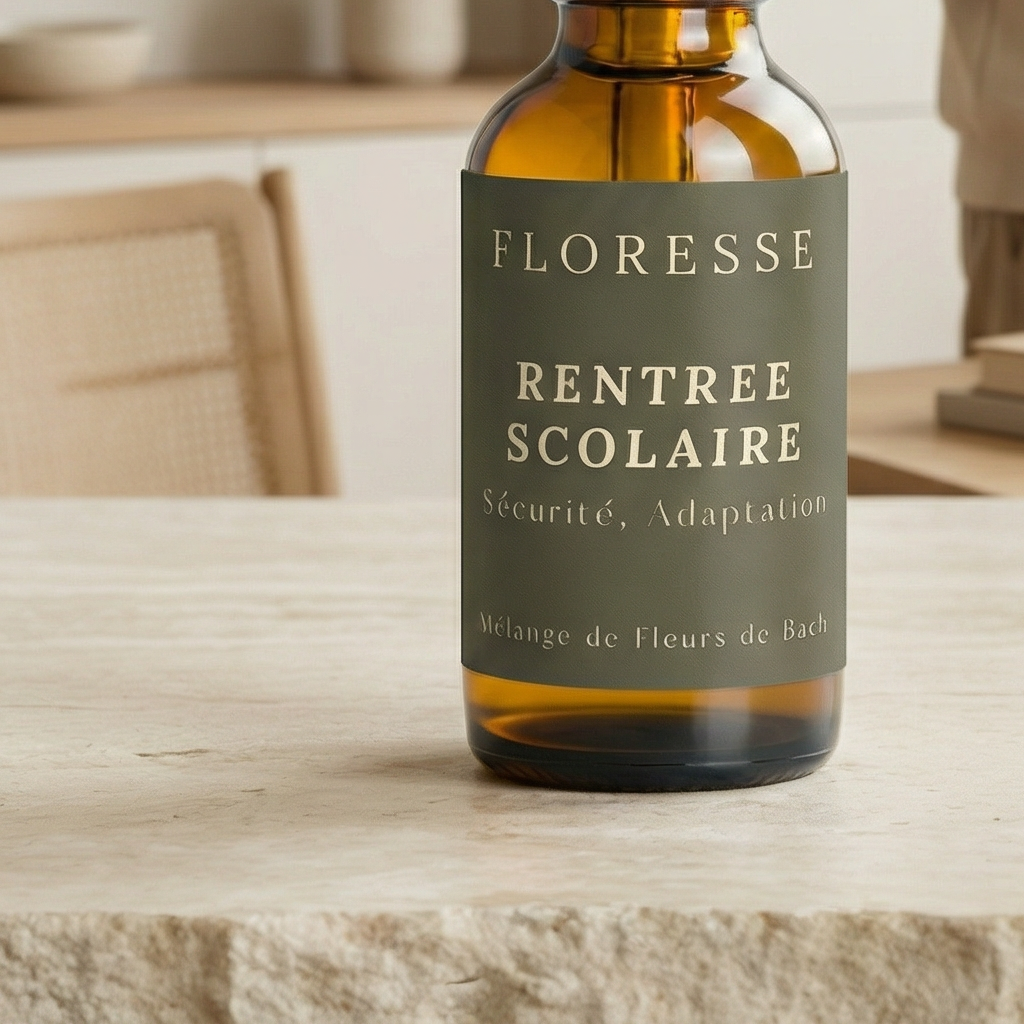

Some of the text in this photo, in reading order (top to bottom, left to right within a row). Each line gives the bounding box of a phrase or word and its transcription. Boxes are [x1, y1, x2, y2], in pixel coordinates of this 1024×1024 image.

[492, 228, 814, 277] FLORESSE
[516, 360, 792, 406] RENTREE
[506, 421, 802, 469] SCOLAIRE
[482, 488, 827, 537] Sécurité, Adaptation
[480, 609, 828, 651] Mélange de Fleurs de Bach
